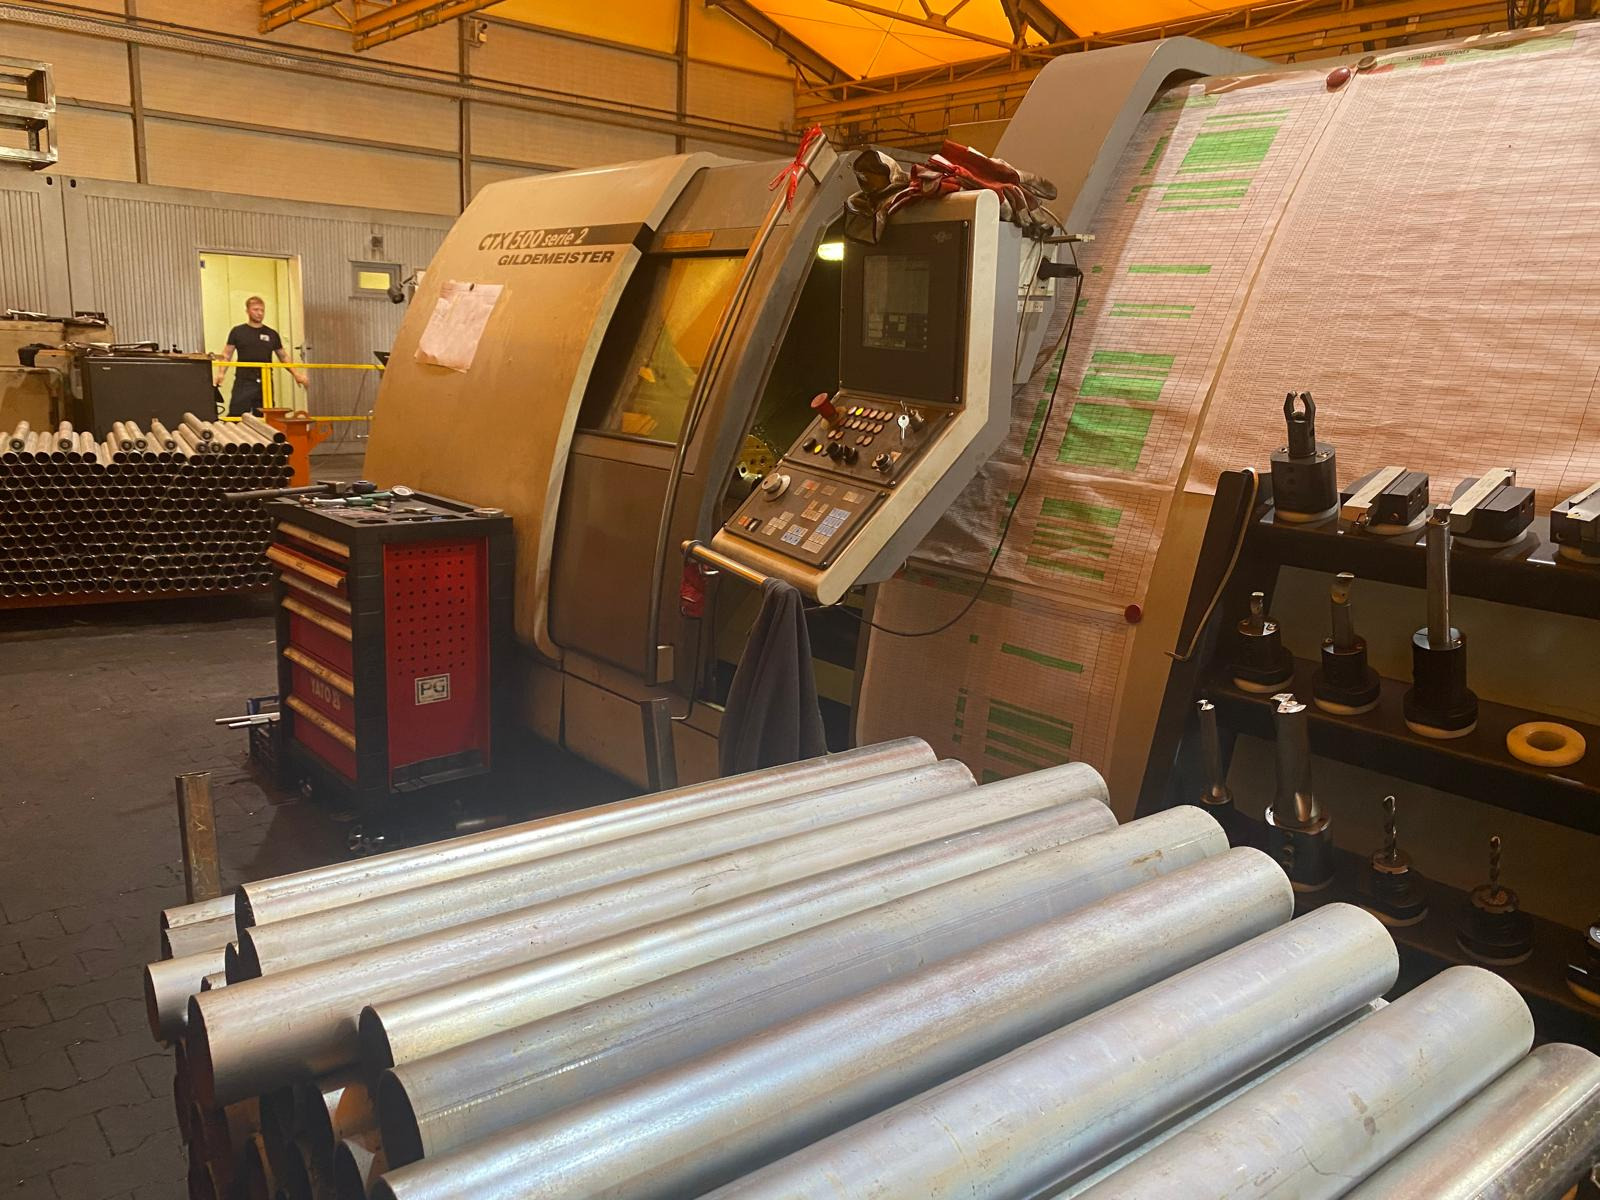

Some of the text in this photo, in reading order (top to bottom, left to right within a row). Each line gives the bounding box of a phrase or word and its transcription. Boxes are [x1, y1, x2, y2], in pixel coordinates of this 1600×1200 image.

[478, 227, 590, 251] CTX 500 serie 2
[497, 251, 615, 266] GILDEMEISTER
[420, 679, 445, 696] PG
